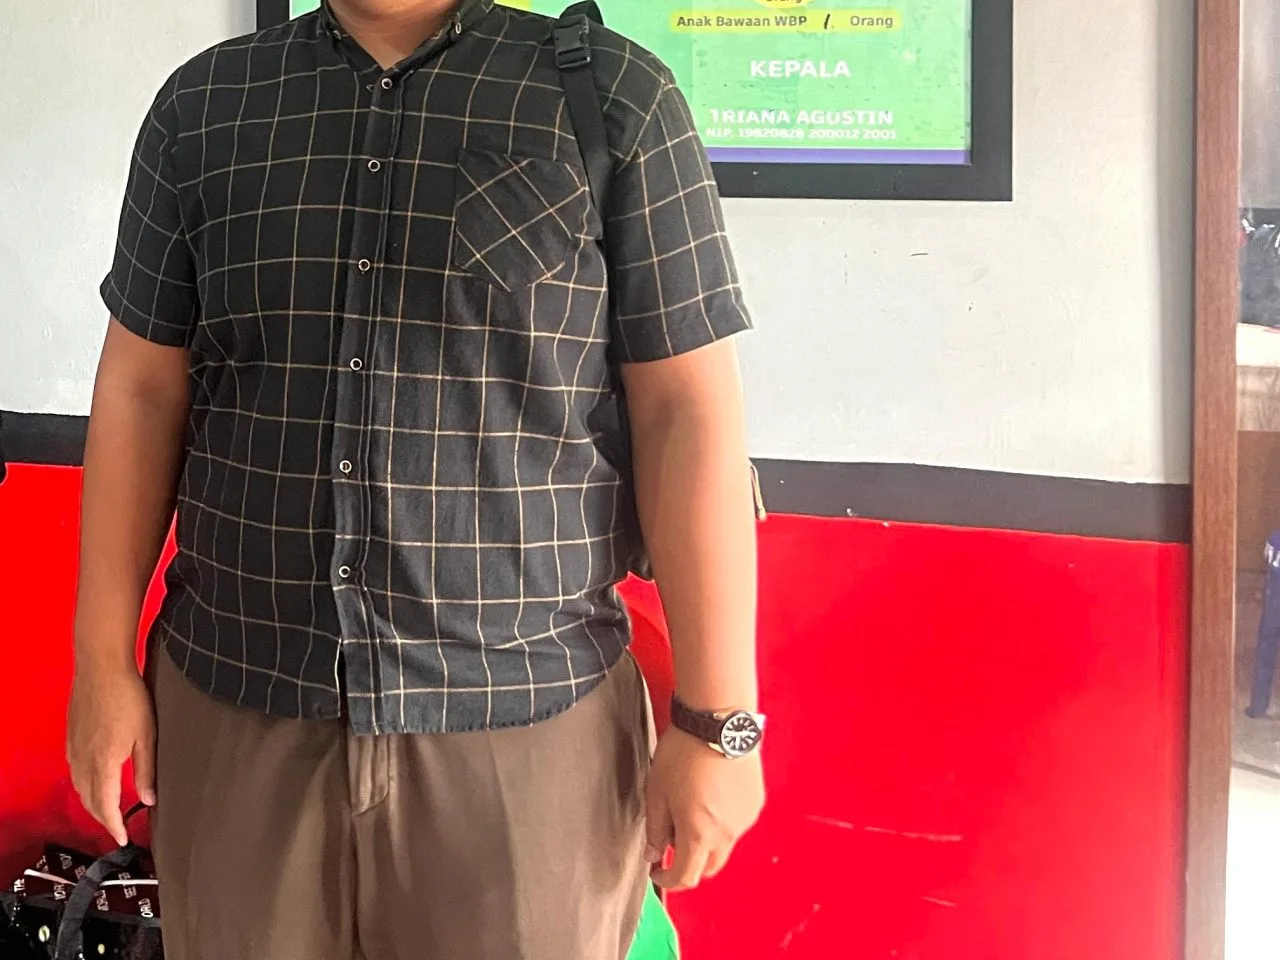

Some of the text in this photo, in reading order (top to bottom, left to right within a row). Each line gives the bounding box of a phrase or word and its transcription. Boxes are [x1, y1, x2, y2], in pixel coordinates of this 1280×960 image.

[677, 15, 893, 28] Anak Bawaan WBP Orang
[750, 60, 851, 78] KEPALA
[709, 108, 893, 125] TRIANA AGUSTIN
